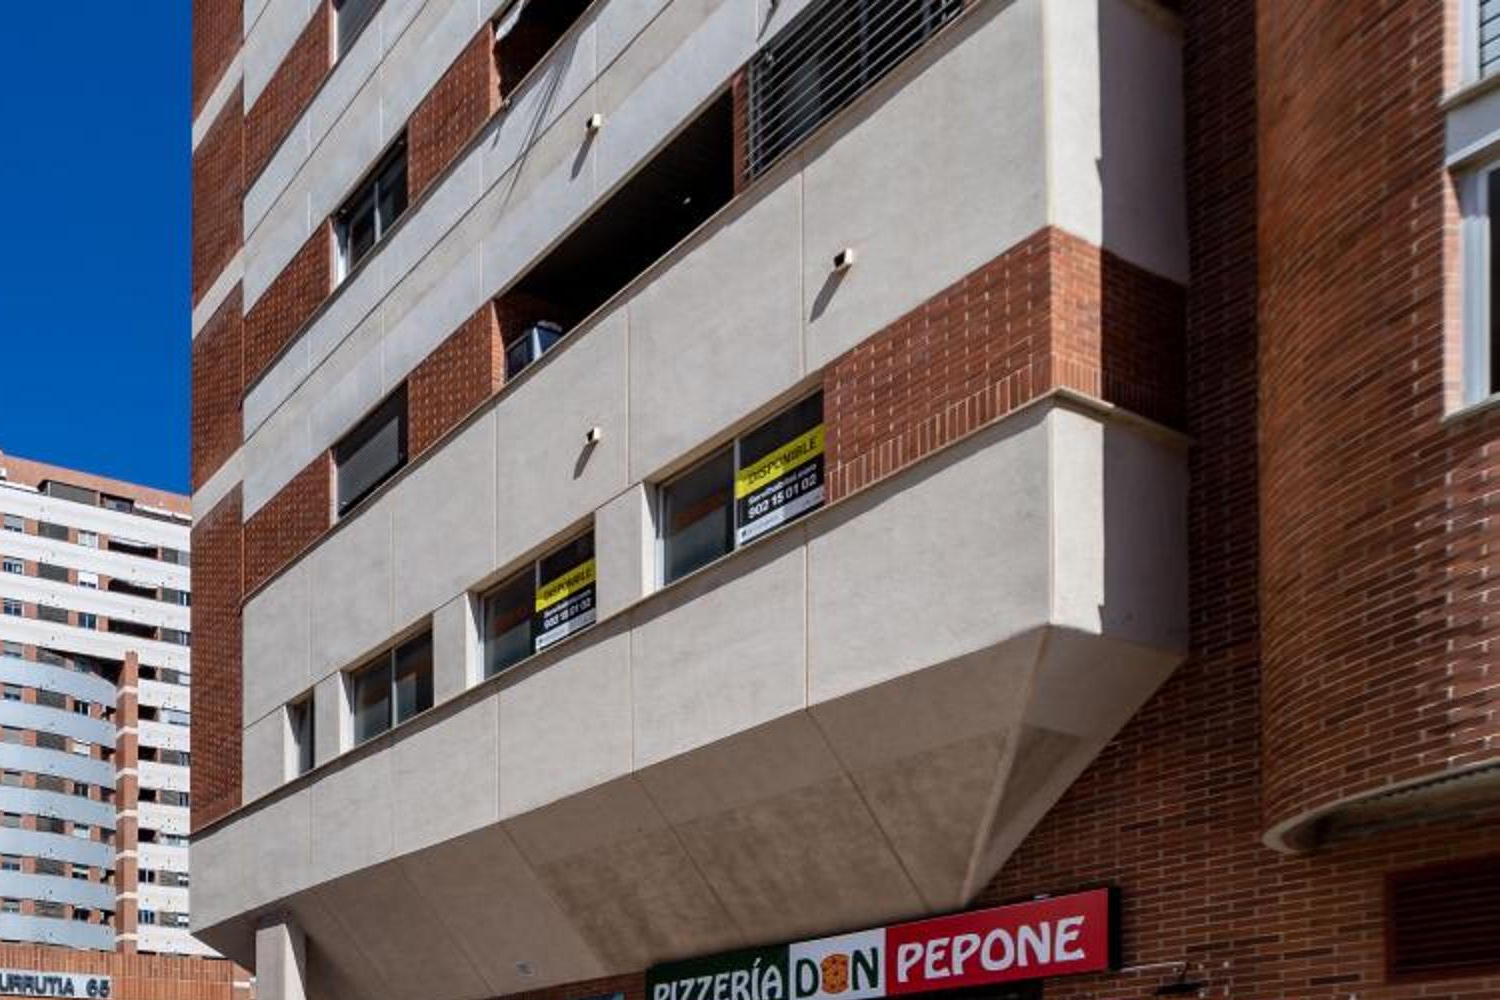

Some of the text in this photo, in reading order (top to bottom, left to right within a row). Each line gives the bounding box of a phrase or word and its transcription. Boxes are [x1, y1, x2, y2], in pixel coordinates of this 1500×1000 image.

[747, 436, 817, 485] DISPONIBLE
[748, 472, 818, 519] 902 15 01 02
[897, 915, 1086, 984] PEPONE
